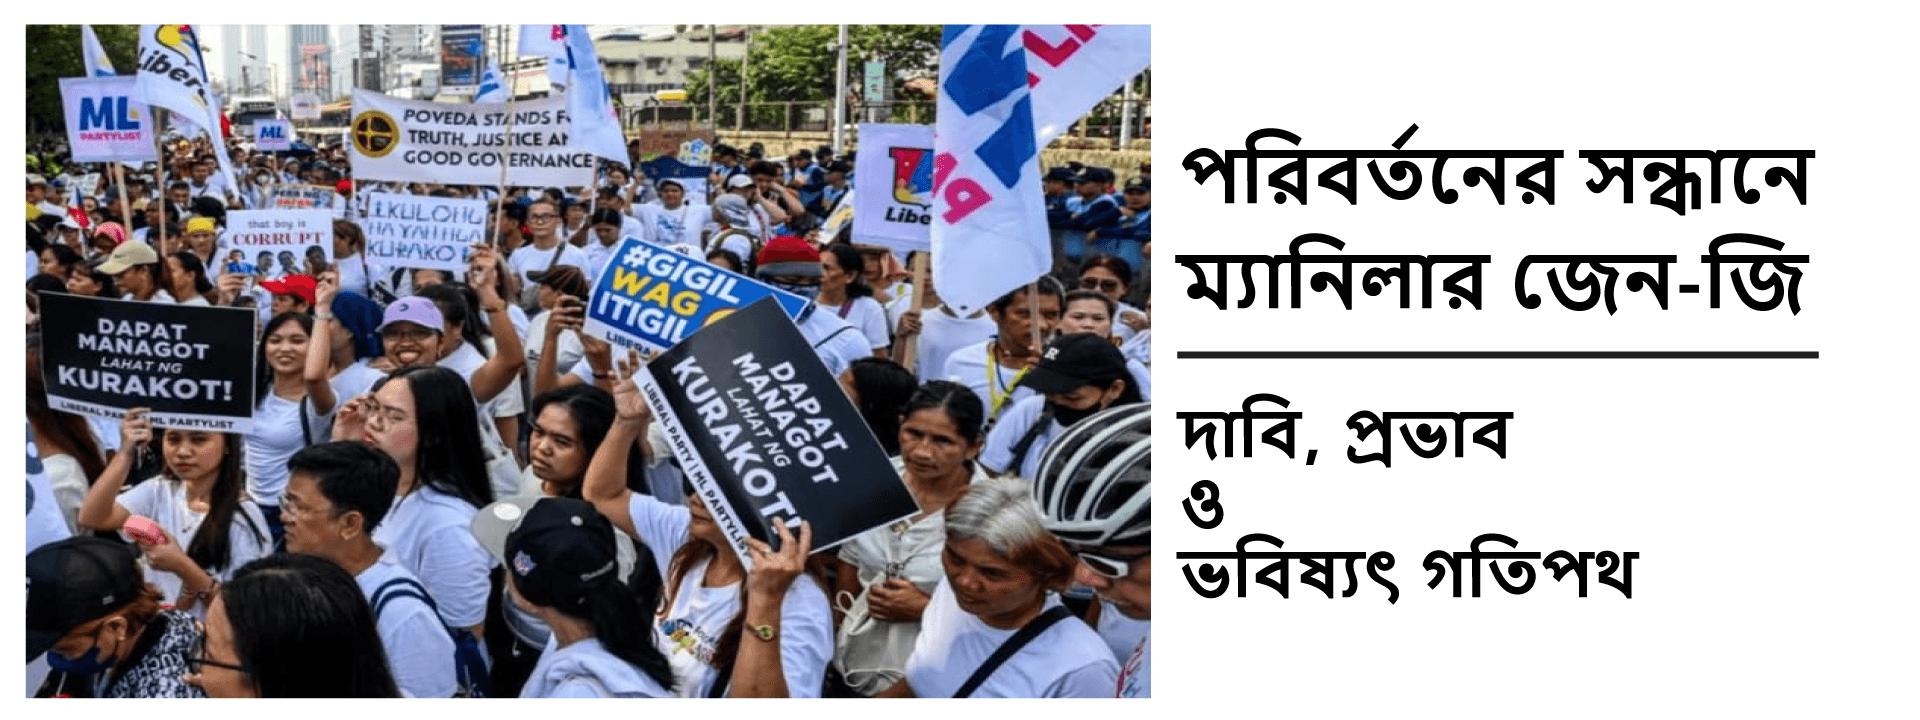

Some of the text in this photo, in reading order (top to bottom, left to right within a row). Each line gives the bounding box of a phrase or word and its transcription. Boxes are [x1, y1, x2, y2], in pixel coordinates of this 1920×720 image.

[79, 96, 141, 131] ML
[403, 108, 477, 126] POVEDA
[483, 111, 551, 126] STANDS
[408, 129, 468, 148] TRUTH,
[472, 132, 542, 147] JUSTICE
[403, 150, 593, 168] GOOD GOVERNANCE
[232, 231, 325, 246] CORRUPT
[247, 221, 270, 229] that
[622, 245, 740, 305] #GIGIL
[612, 266, 702, 317] WAG
[97, 318, 187, 340] DAPAT
[78, 333, 210, 360] MANAGOT
[100, 356, 183, 374] LAHAT NG
[58, 364, 233, 402] KURAKOT!
[60, 400, 101, 418] LIBERAL
[169, 417, 234, 430] PARTYLIST
[732, 352, 839, 484] MANAGOT
[768, 361, 849, 450] DAPAT
[643, 382, 671, 427] LIBERAL
[668, 426, 695, 462] PARTY
[695, 470, 708, 489] ML
[726, 386, 792, 467] LAHAT NG
